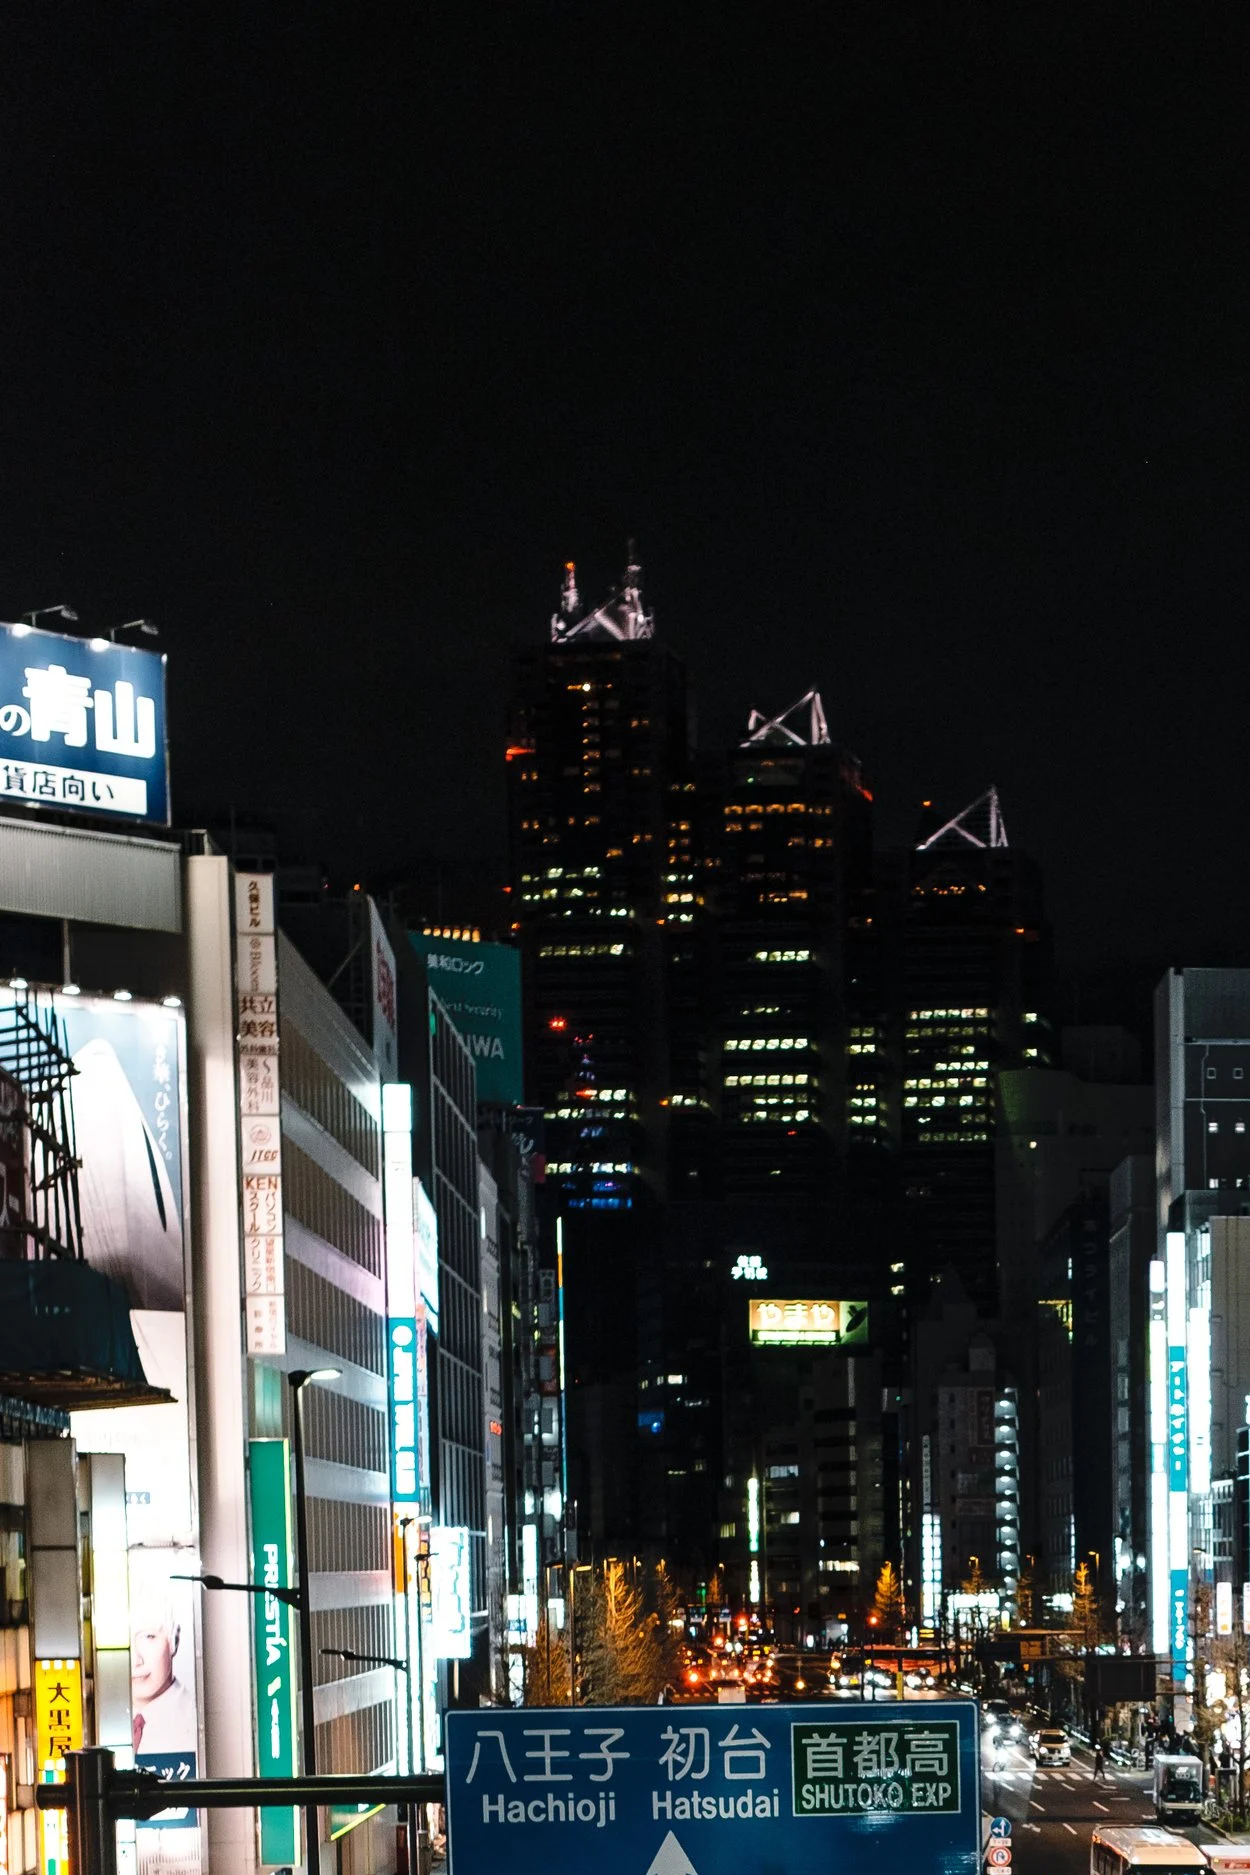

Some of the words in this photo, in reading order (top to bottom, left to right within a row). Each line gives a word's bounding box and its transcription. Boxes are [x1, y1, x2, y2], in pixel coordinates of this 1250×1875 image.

[0, 664, 156, 759] の青山
[3, 765, 114, 799] 貨店向い
[461, 1034, 505, 1060] IWA
[245, 1176, 278, 1190] KEN
[249, 1191, 261, 1232] スクール
[265, 1191, 277, 1232] パソコン
[756, 1302, 836, 1331] やまや
[465, 1728, 630, 1784] 八王子
[658, 1724, 772, 1782] 初台
[801, 1730, 951, 1779] 首都高
[482, 1792, 616, 1827] Hachioji
[652, 1790, 780, 1819] Hatsudai
[801, 1784, 904, 1811] SHUTOKO
[912, 1783, 952, 1808] EXP
